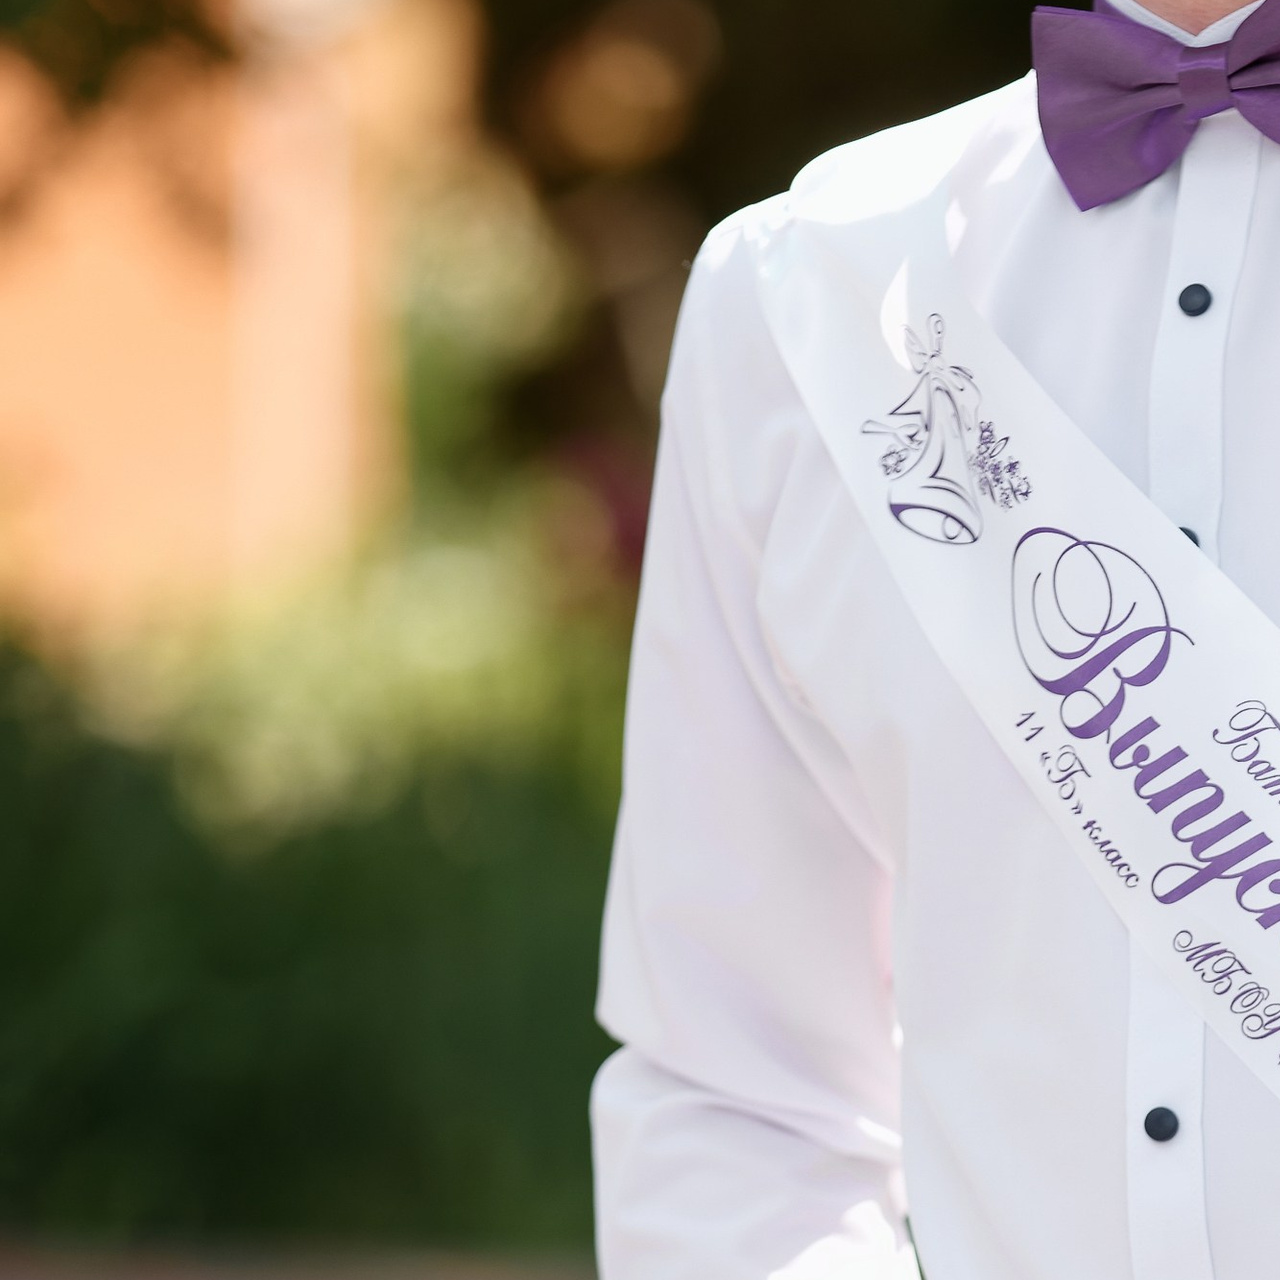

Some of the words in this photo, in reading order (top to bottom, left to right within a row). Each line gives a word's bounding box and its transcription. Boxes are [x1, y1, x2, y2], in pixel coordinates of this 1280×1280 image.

[1015, 711, 1044, 742] 11
[1040, 744, 1092, 816] «Б»
[1082, 818, 1140, 889] класс
